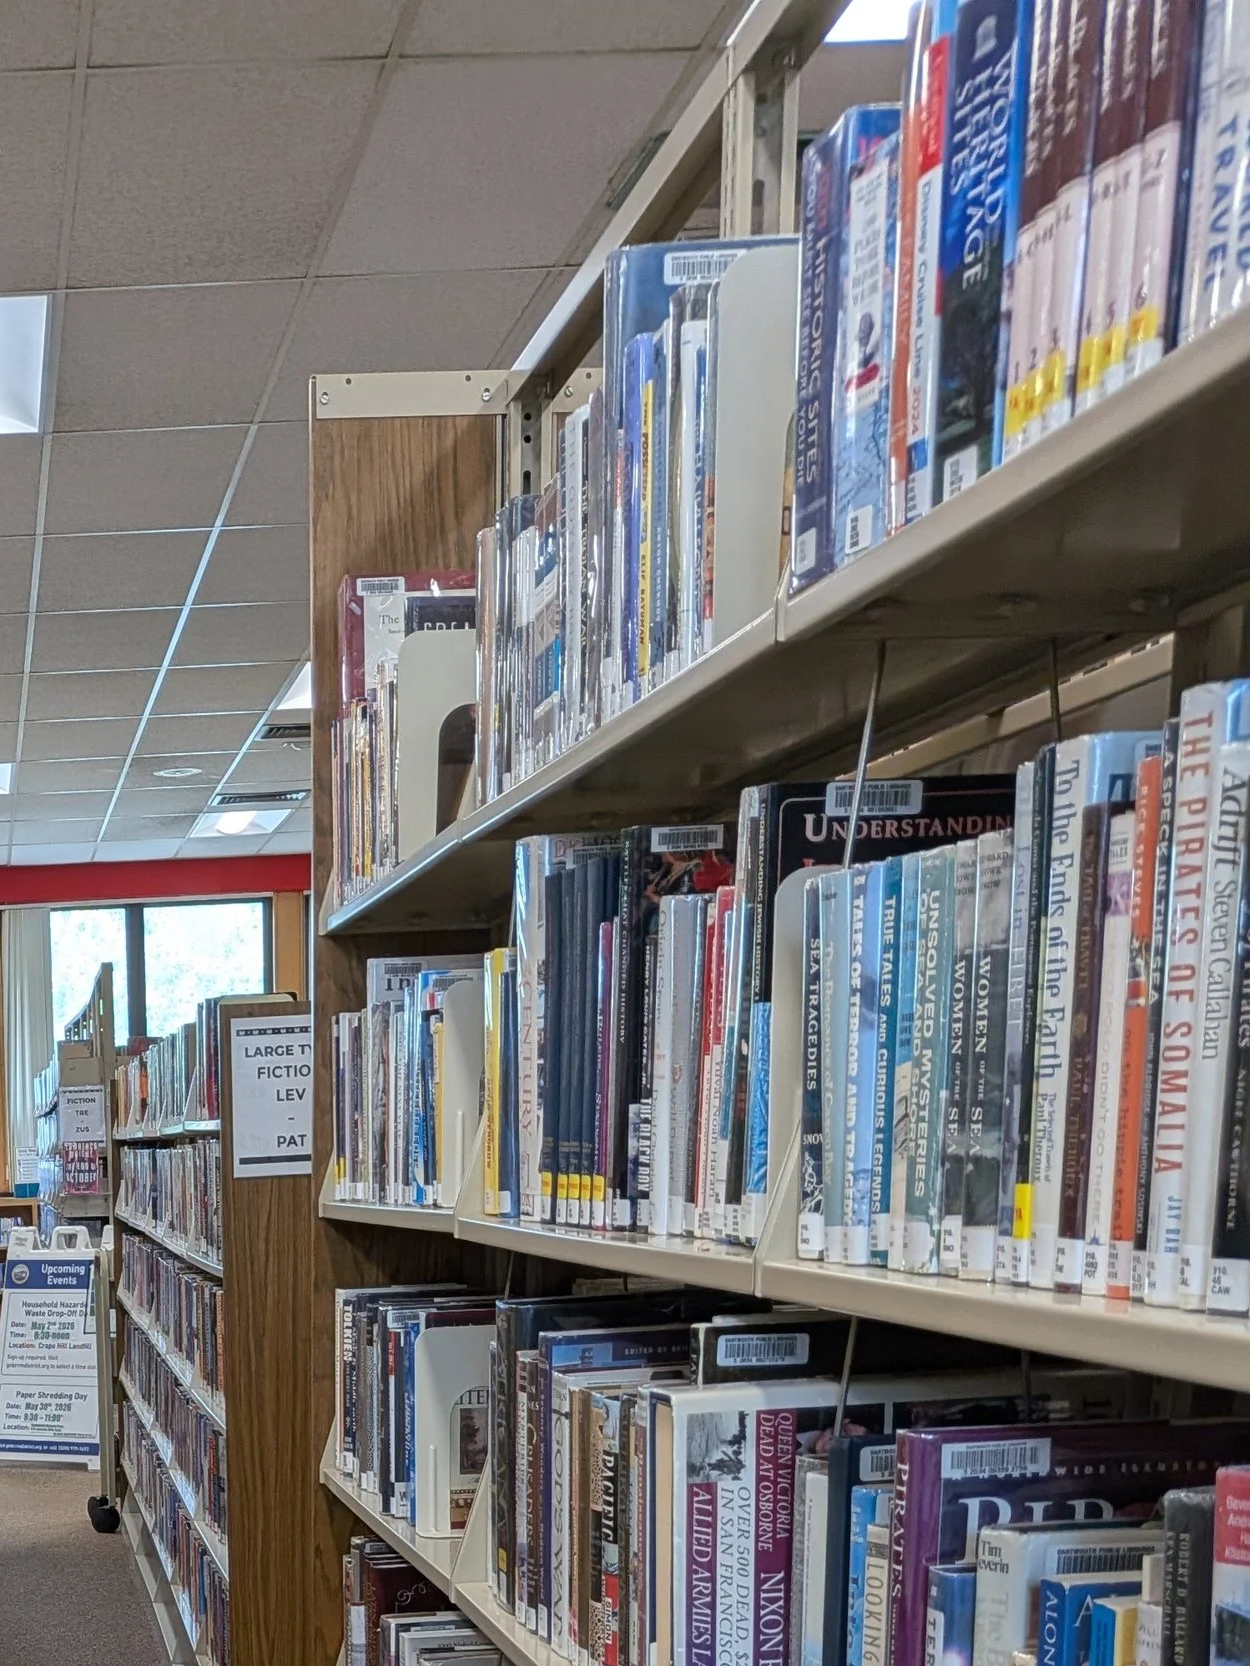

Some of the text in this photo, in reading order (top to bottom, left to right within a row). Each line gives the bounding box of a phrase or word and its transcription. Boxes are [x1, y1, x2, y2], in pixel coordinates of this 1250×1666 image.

[950, 83, 974, 197] SITES
[962, 42, 1015, 292] WORLD HERITAGE
[803, 235, 830, 486] HISTORIC SITES
[1157, 778, 1173, 857] SPECK
[1038, 755, 1080, 1078] To the Ends the Earth
[1154, 710, 1214, 1174] THE PIRATES OF SOMALIA
[1202, 765, 1249, 1061] Adrift Steven Callahan
[806, 938, 820, 1091] SEA TRAGEDIES
[847, 895, 864, 1077] TALES TERROR
[949, 960, 967, 1056] WOMEN
[244, 1044, 294, 1058] LARGE
[257, 1064, 311, 1080] FICTIO
[871, 895, 896, 1214] TRUE TALES CURIOUS LEGENDS
[914, 890, 941, 1197] UNSOLVED MYSTERIES
[969, 955, 992, 1156] WOMEN SEA
[66, 1097, 96, 1105] FICTION
[276, 1088, 306, 1102] LEV
[276, 1134, 307, 1148] PAT
[41, 1264, 85, 1275] Upcoming
[47, 1275, 77, 1285] Events
[1211, 1288, 1231, 1298] CAW
[21, 1300, 58, 1309] Household
[31, 1322, 46, 1331] May
[47, 1309, 77, 1318] Drop-Off
[343, 1305, 354, 1361] TOLKIEN
[15, 1391, 88, 1402] Paper Shredding Day
[25, 1402, 39, 1411] May
[601, 1450, 616, 1542] PACIFIC
[721, 1487, 735, 1511] IN
[758, 1413, 775, 1552] DEAD AT OSBORNE
[774, 1413, 793, 1539] QUEEN VICTORIA
[692, 1486, 713, 1562] ALLIED
[720, 1516, 734, 1556] SAN
[737, 1486, 751, 1540] OVER
[892, 1462, 910, 1597] PIRATES
[736, 1545, 750, 1579] 500
[981, 1539, 1002, 1558] Tim
[604, 1598, 612, 1643] SIMON
[692, 1565, 713, 1645] ARMIES
[735, 1585, 750, 1647] DEAD,
[759, 1570, 785, 1652] NIXON
[862, 1564, 885, 1666] LOOKING
